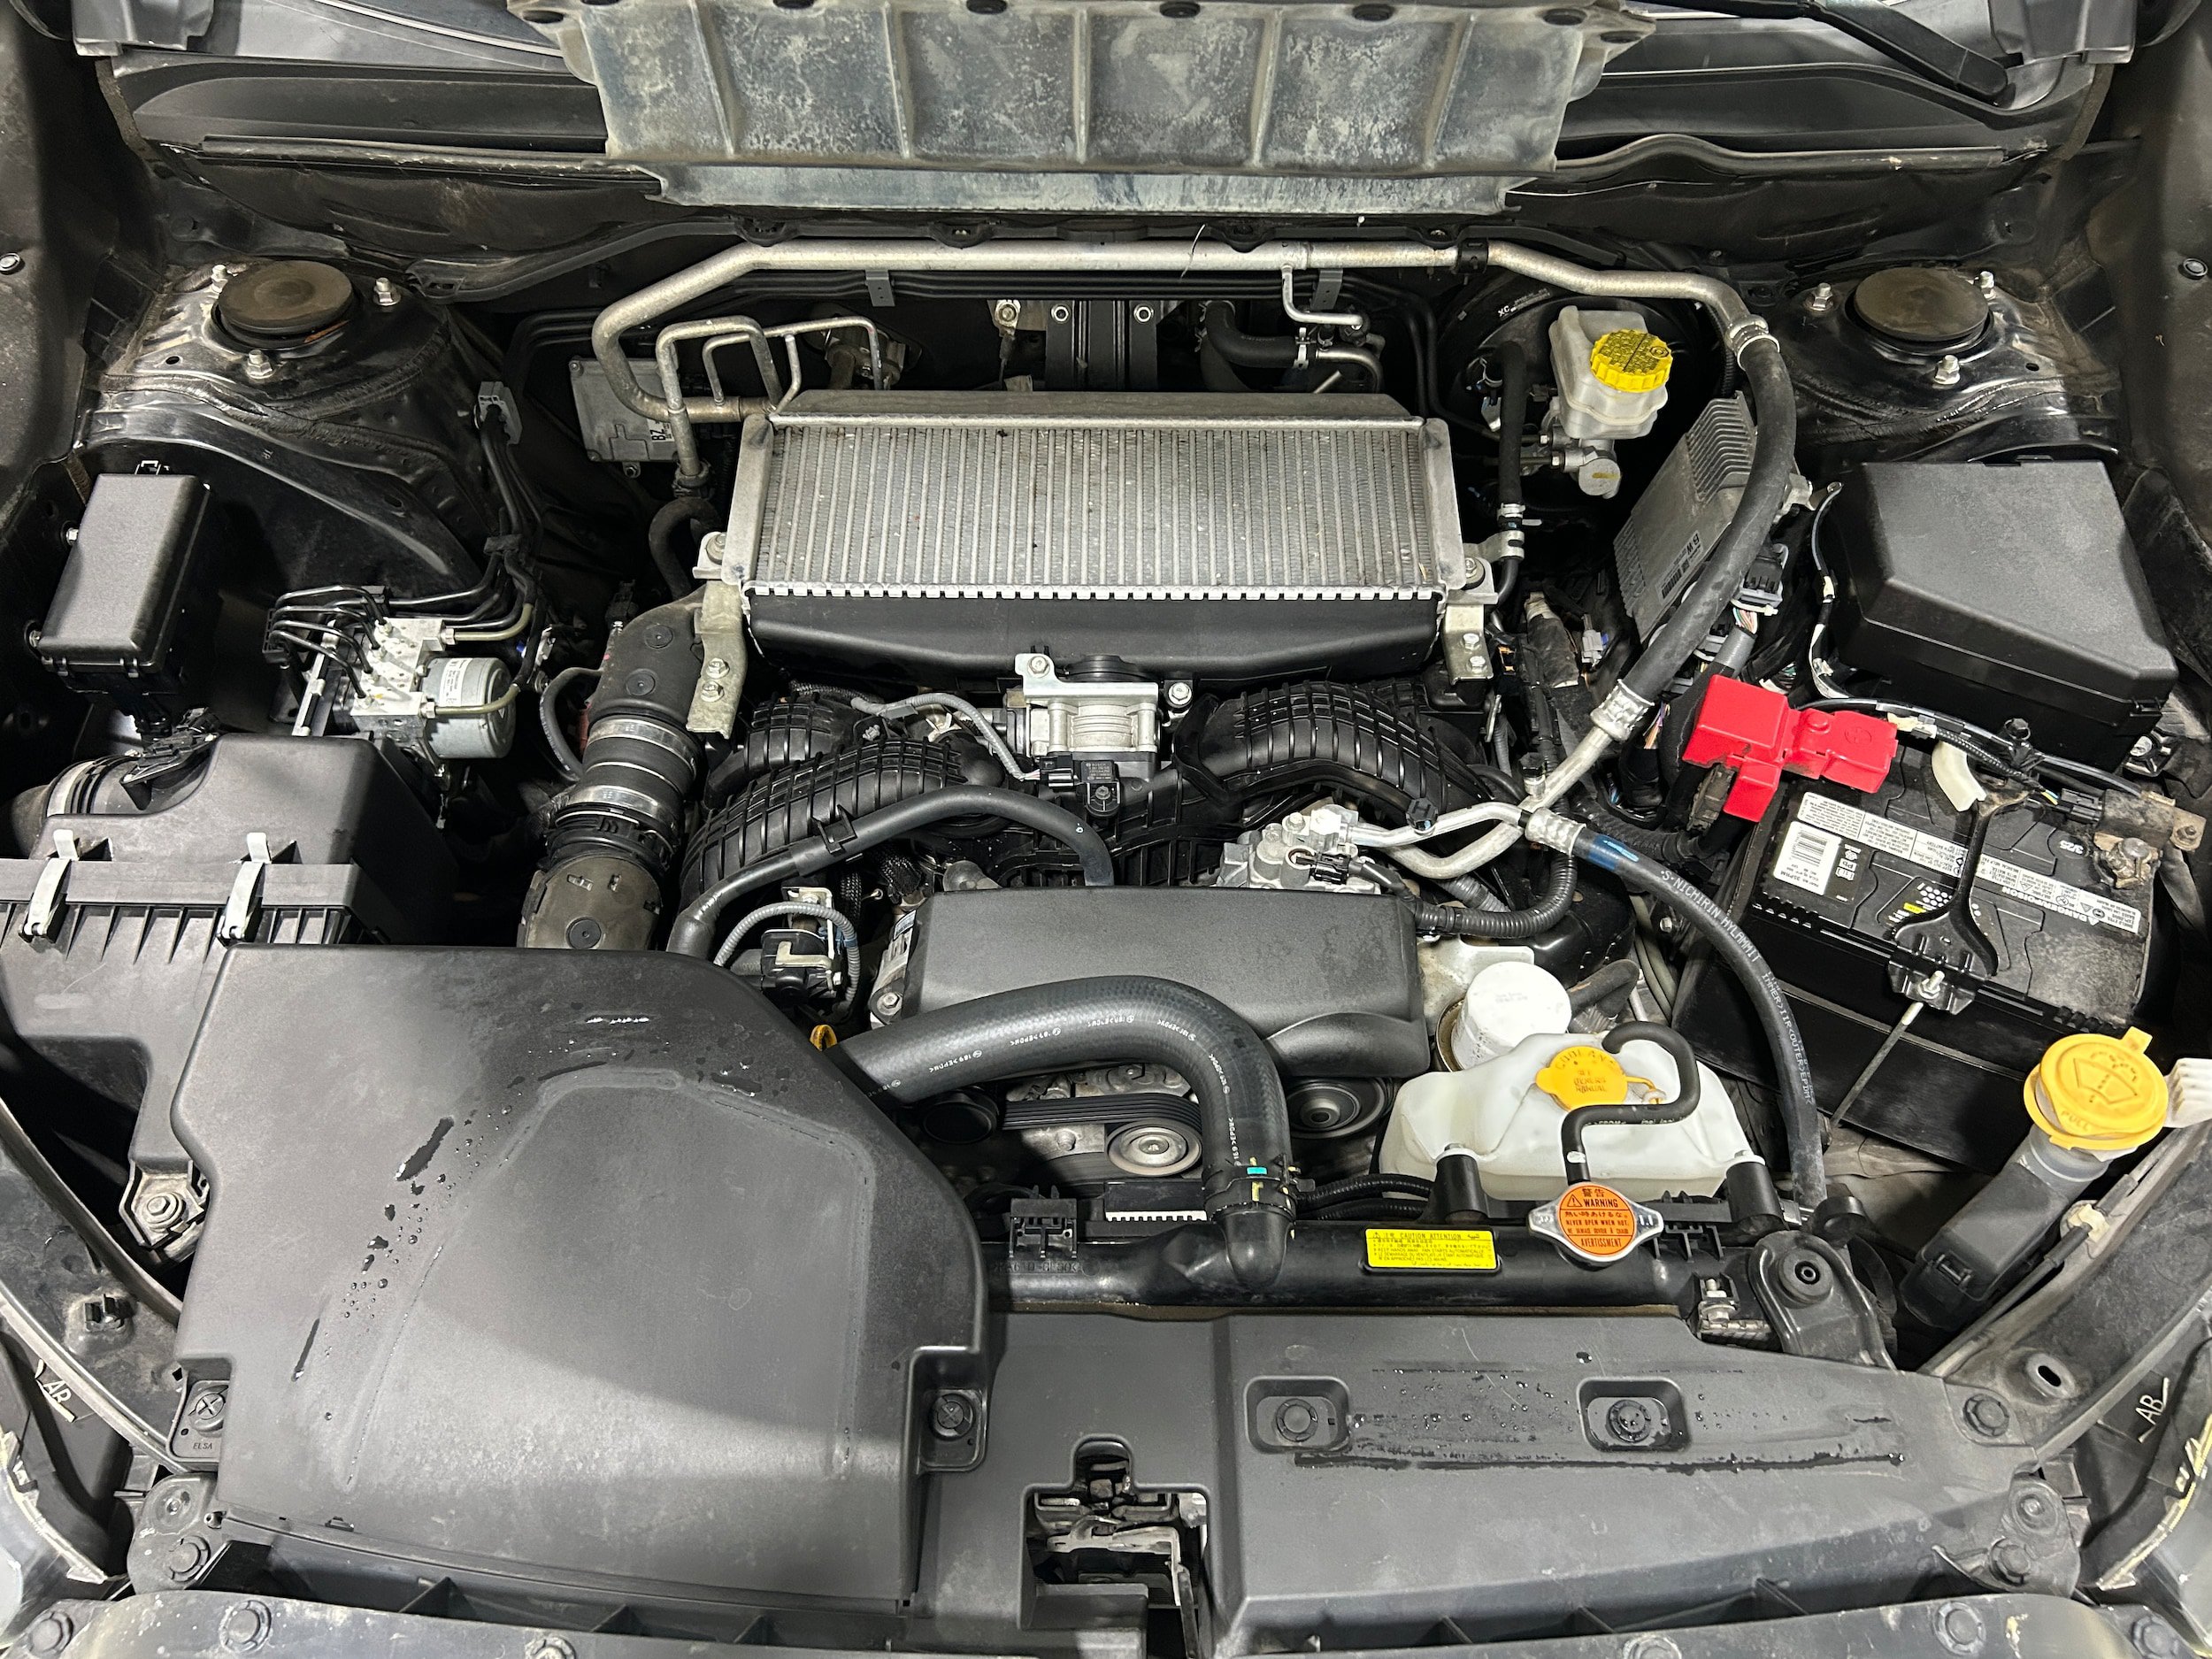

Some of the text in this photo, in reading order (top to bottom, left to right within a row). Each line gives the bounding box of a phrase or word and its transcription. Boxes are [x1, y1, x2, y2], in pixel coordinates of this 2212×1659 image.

[649, 428, 665, 440] BZ
[1841, 860, 1854, 869] Pb
[1721, 916, 1763, 963] HYLAMMIT
[1583, 1199, 1618, 1208] WARNING
[43, 1379, 73, 1403] AR
[2135, 1394, 2163, 1425] AB
